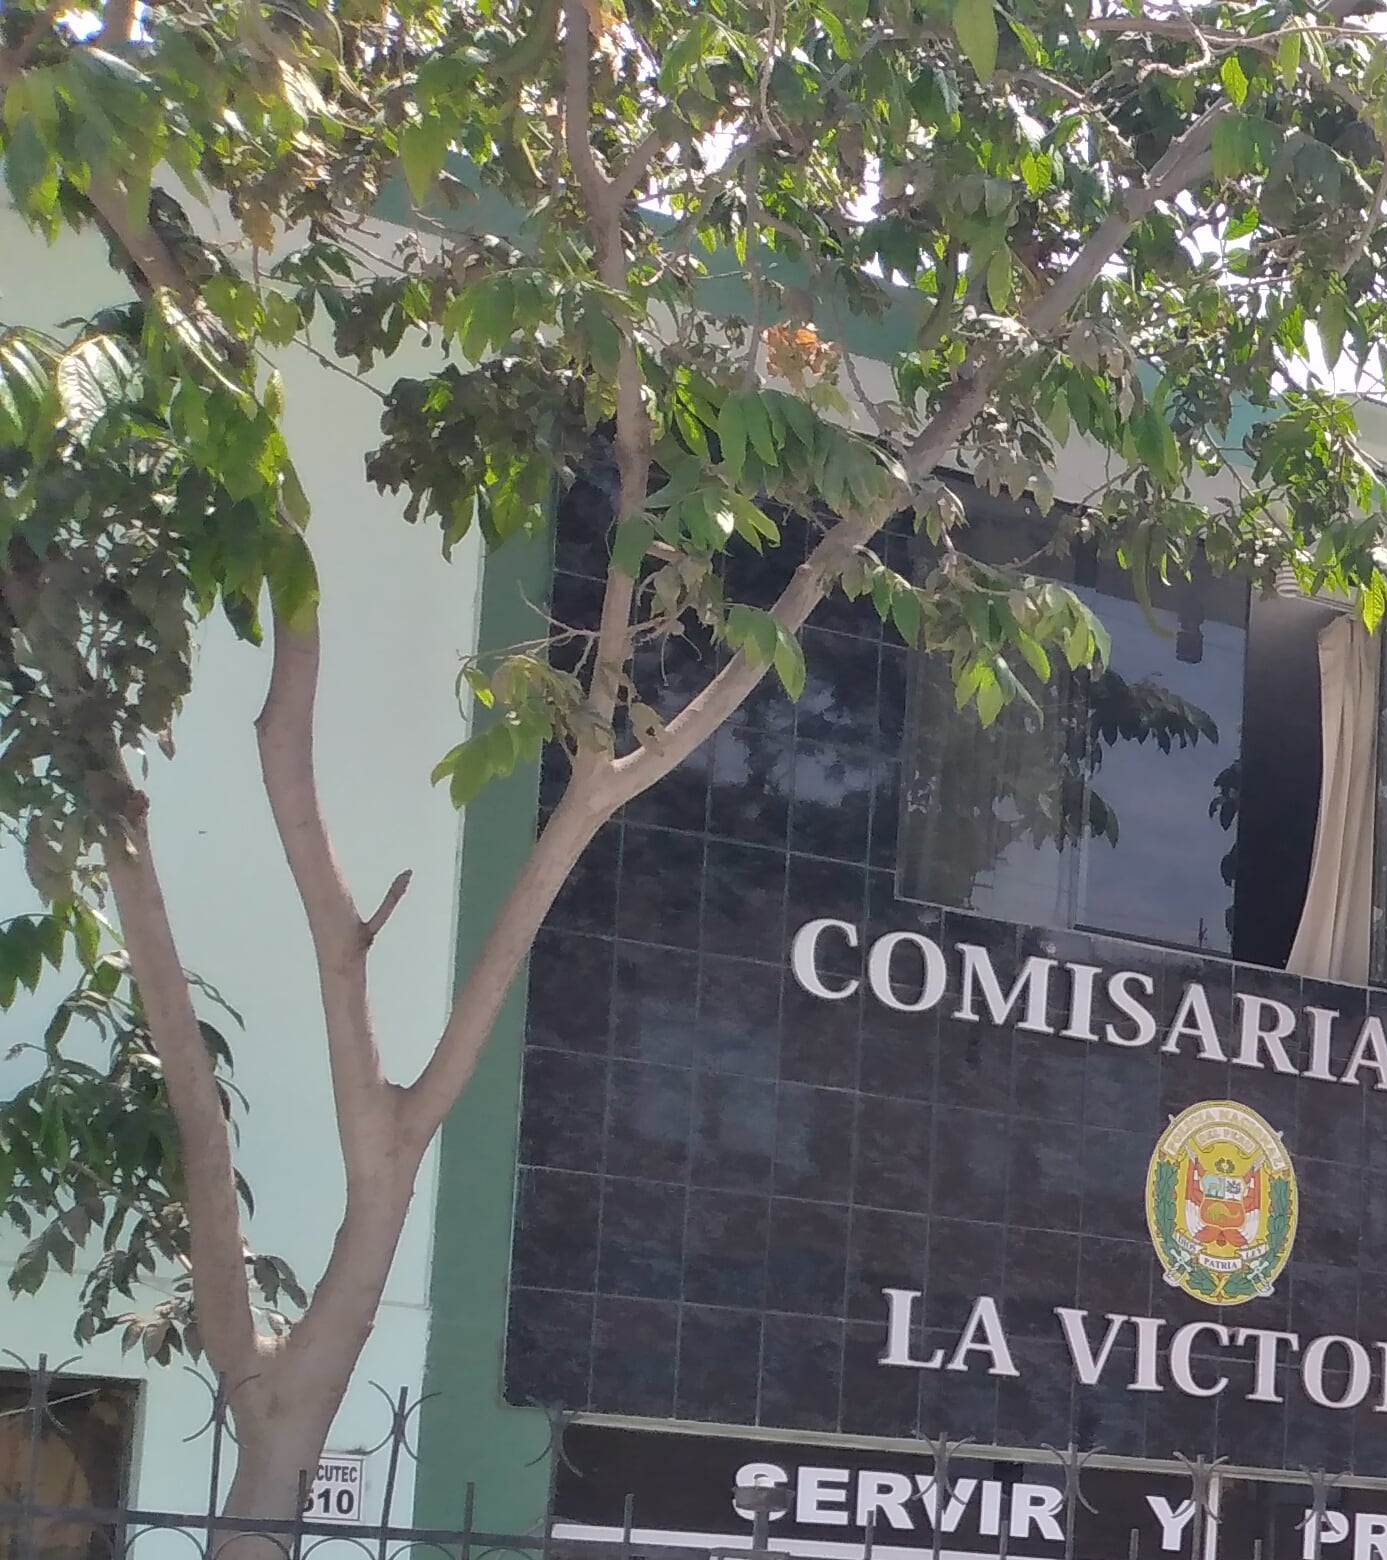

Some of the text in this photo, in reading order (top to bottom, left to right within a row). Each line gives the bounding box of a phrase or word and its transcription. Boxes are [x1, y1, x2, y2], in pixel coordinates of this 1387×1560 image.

[1204, 1257, 1239, 1270] PATRIA
[880, 1288, 1020, 1377] LA
[1146, 1495, 1197, 1551] Y
